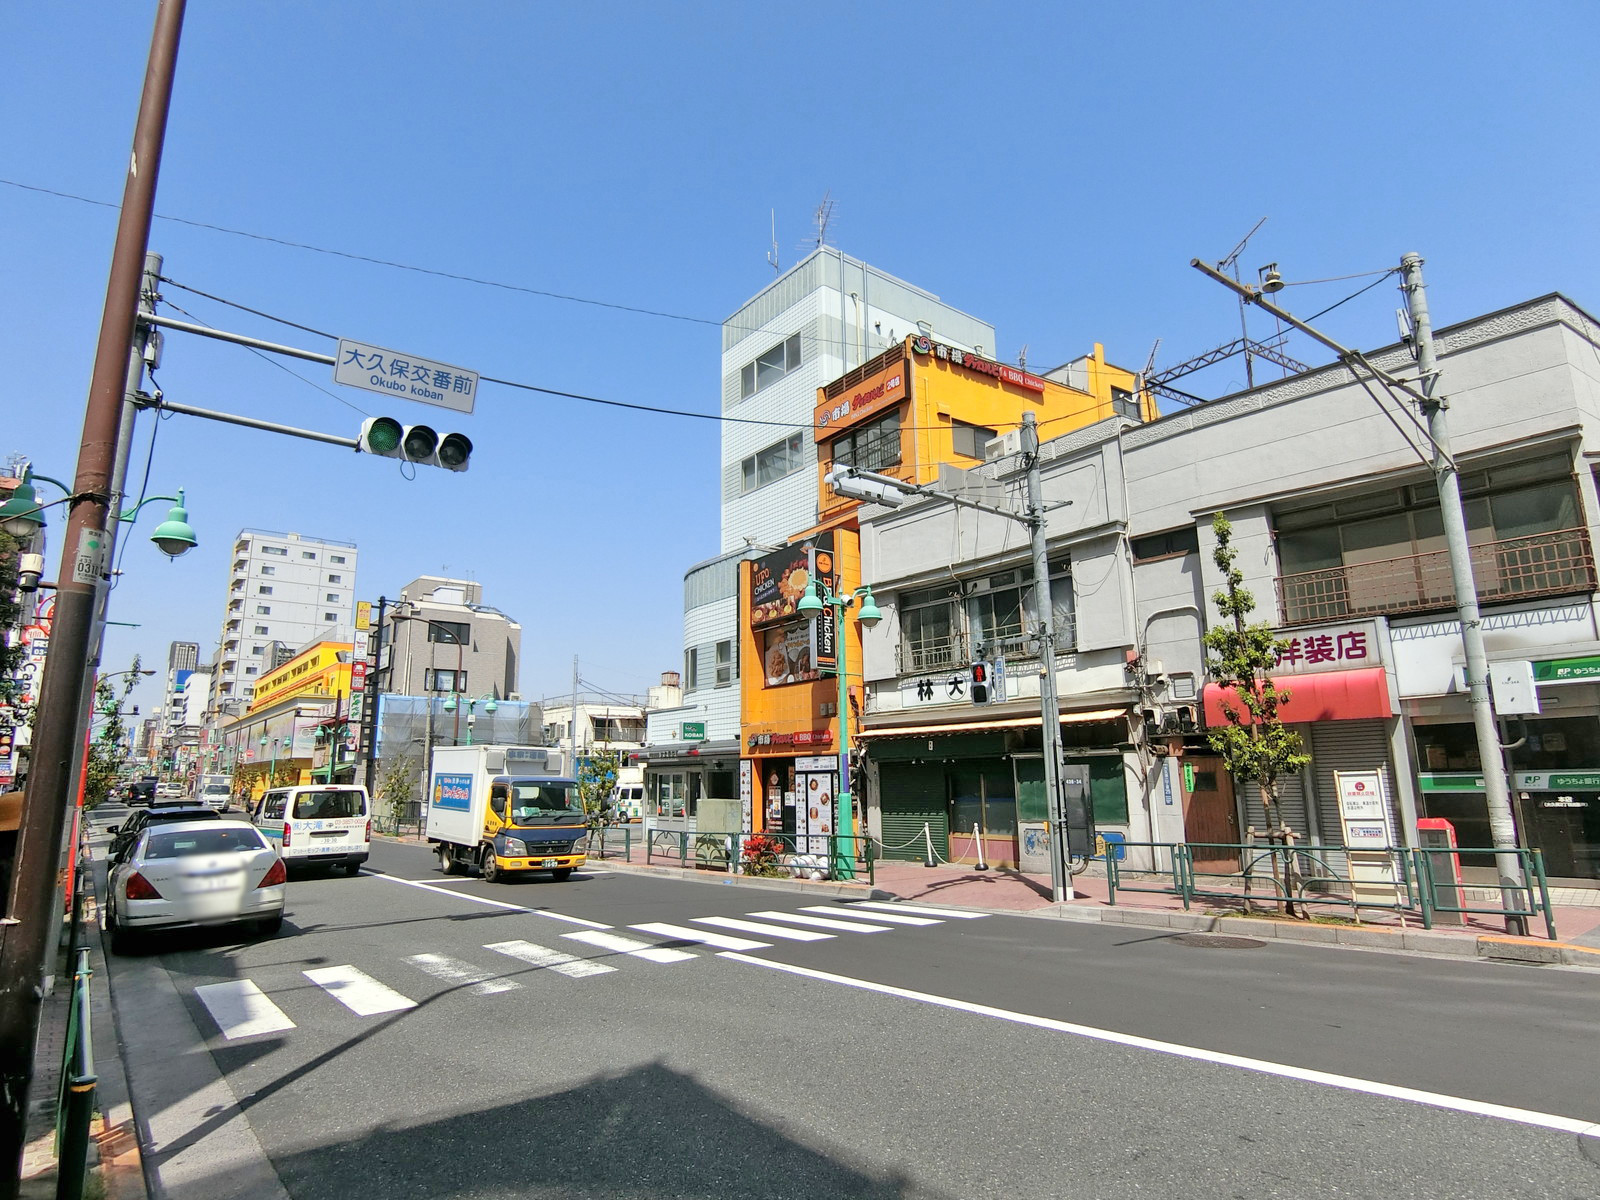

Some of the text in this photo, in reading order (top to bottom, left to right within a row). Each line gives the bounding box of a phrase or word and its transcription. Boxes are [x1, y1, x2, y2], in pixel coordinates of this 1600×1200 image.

[343, 349, 473, 396] 大久保交番前
[1008, 370, 1024, 385] BBQ
[1024, 377, 1045, 389] Chicken
[370, 375, 444, 401] Okubo koban
[754, 577, 775, 596] CHICKEN
[755, 568, 770, 586] UFO
[822, 607, 835, 654] Chicken
[22, 663, 37, 691] Can
[917, 676, 964, 702] 林 大
